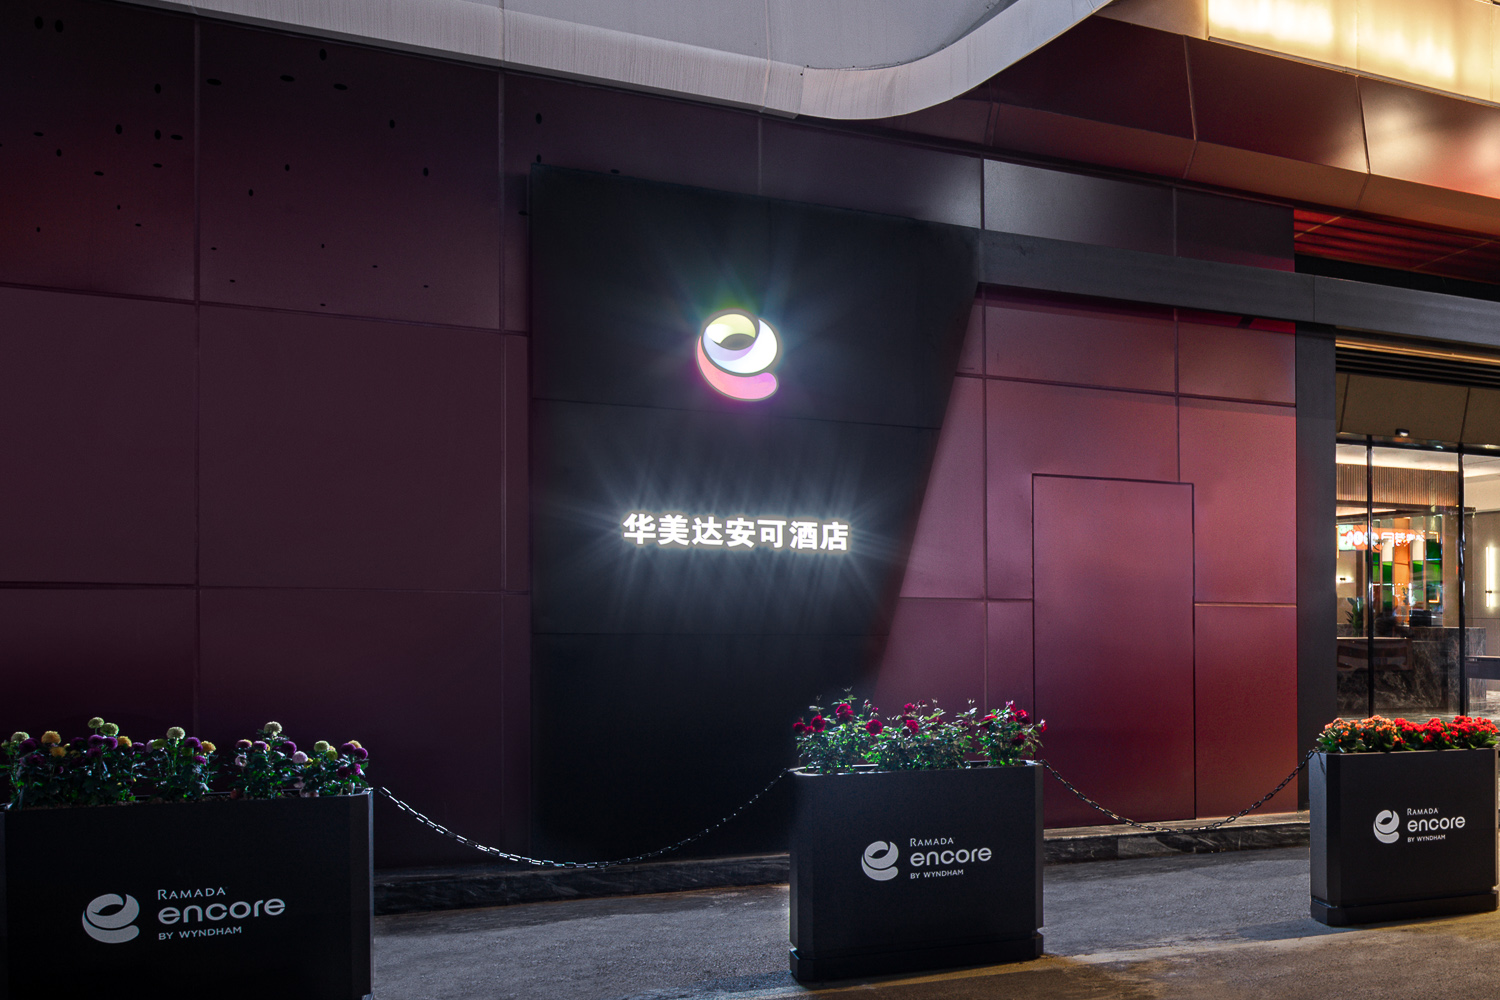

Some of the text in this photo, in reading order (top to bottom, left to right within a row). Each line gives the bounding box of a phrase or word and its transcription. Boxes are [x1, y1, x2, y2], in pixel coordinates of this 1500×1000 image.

[622, 513, 849, 551] 华美达安可酒店
[1407, 807, 1439, 816] RAMADA
[1407, 816, 1466, 832] encore
[909, 837, 954, 848] RAMADA
[1416, 834, 1446, 842] WYNDHAM
[909, 847, 993, 867] encore
[910, 868, 964, 880] BY WYNDHAM
[157, 886, 227, 901] RAMADA
[157, 898, 286, 925] encore
[158, 926, 242, 941] BY WYNDHAM
